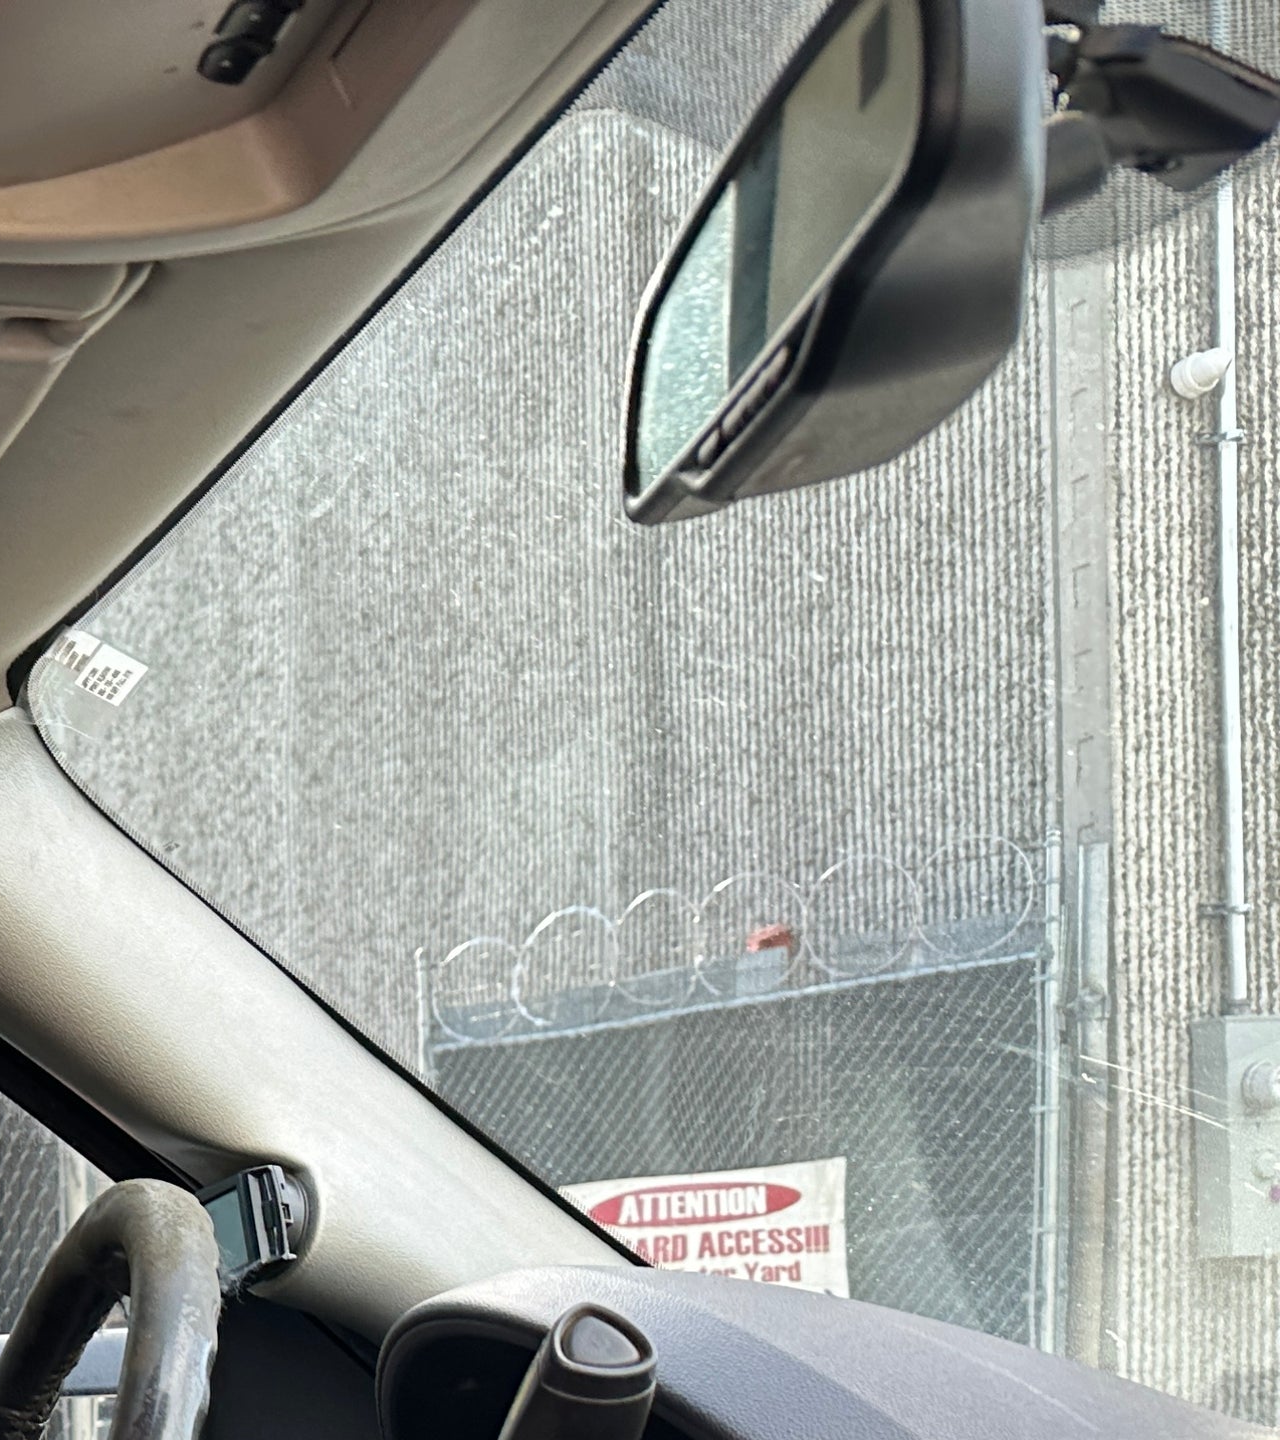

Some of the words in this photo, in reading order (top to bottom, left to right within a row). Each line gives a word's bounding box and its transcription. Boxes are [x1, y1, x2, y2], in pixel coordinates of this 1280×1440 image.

[618, 1185, 767, 1225] ATTENTION
[636, 1234, 688, 1263] ARD
[698, 1225, 831, 1259] ACCESS!!!
